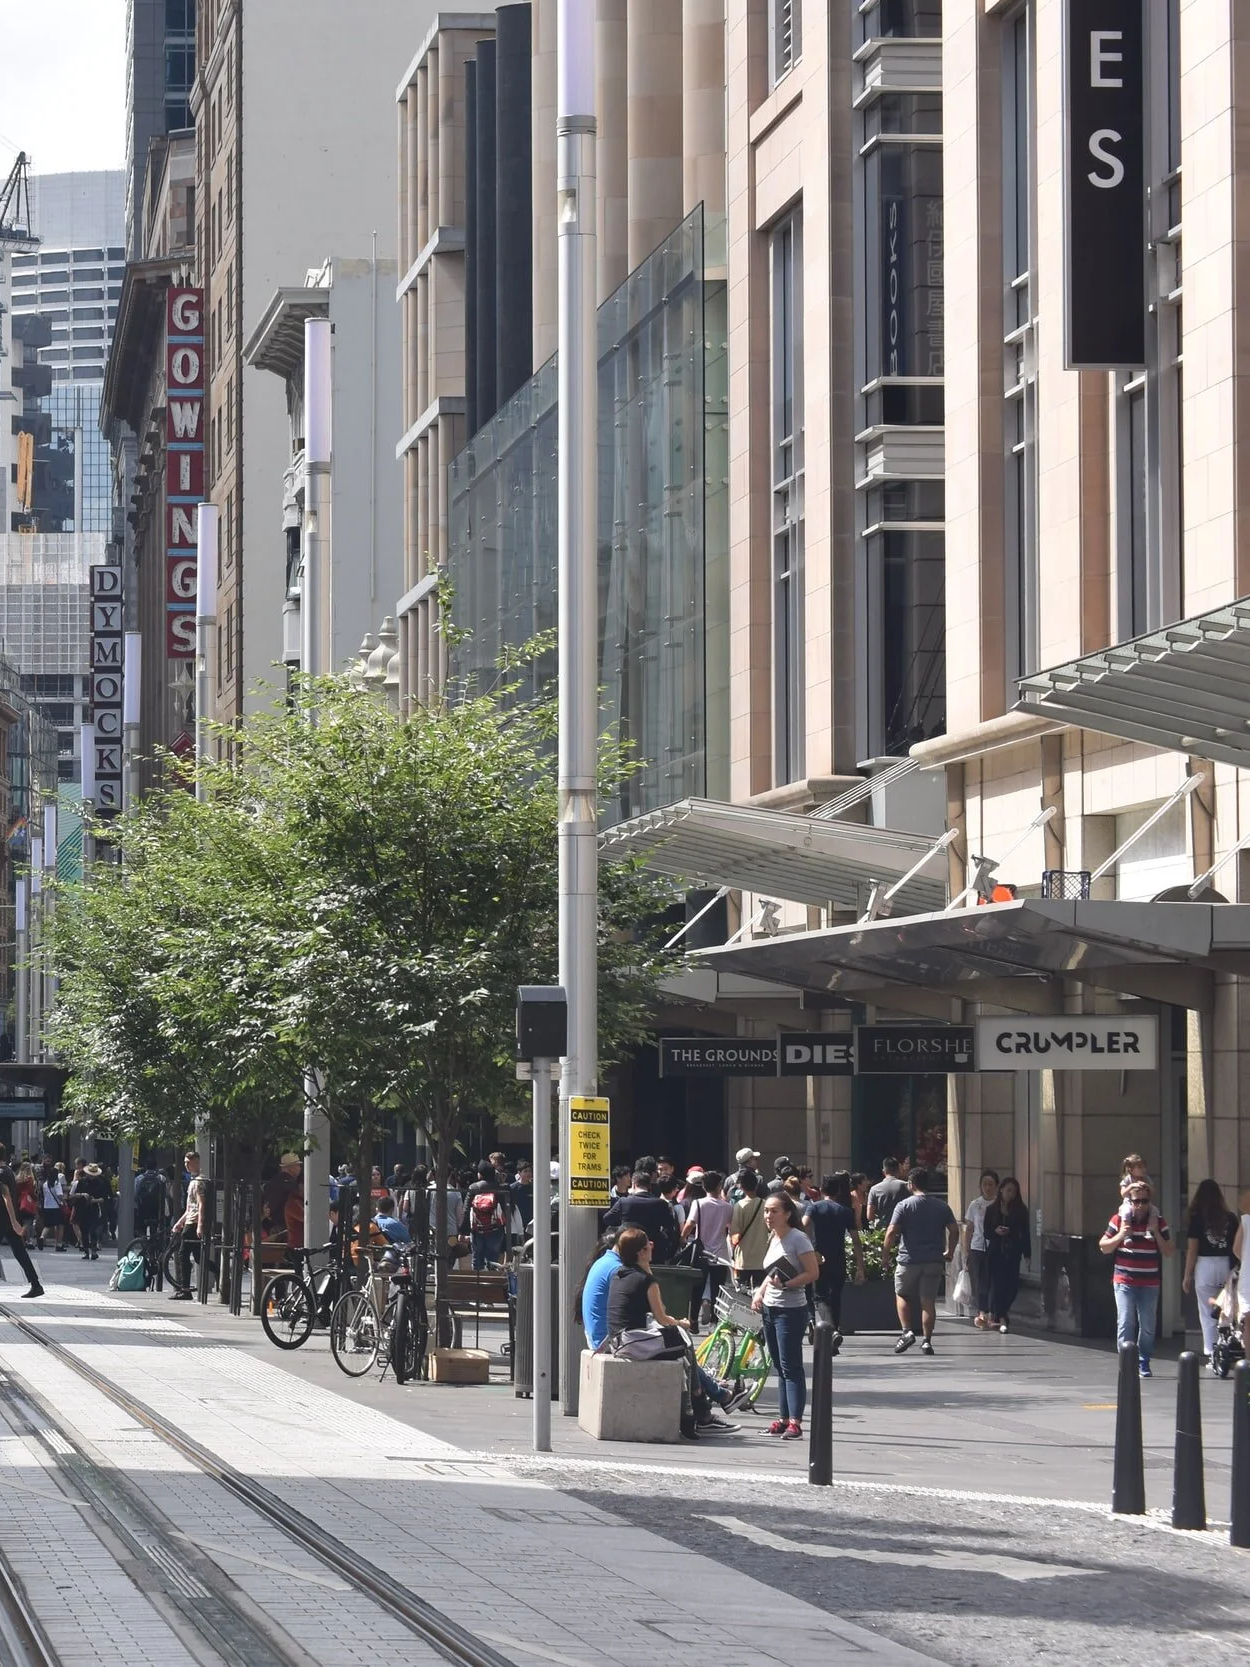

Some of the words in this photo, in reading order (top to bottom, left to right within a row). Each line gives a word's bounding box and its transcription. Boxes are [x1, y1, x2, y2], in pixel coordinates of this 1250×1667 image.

[171, 293, 200, 652] GOWINGS
[95, 571, 119, 806] DYMOCKS
[995, 1031, 1141, 1054] CRUMPLER
[671, 1049, 700, 1062] THE
[785, 1045, 854, 1064] DIE
[572, 1111, 607, 1121] CAUTION
[578, 1131, 601, 1139] CHECK
[579, 1141, 600, 1150] TWICE
[583, 1152, 597, 1160] FOR
[578, 1162, 602, 1171] TRAMS
[572, 1179, 608, 1189] CAUTION
